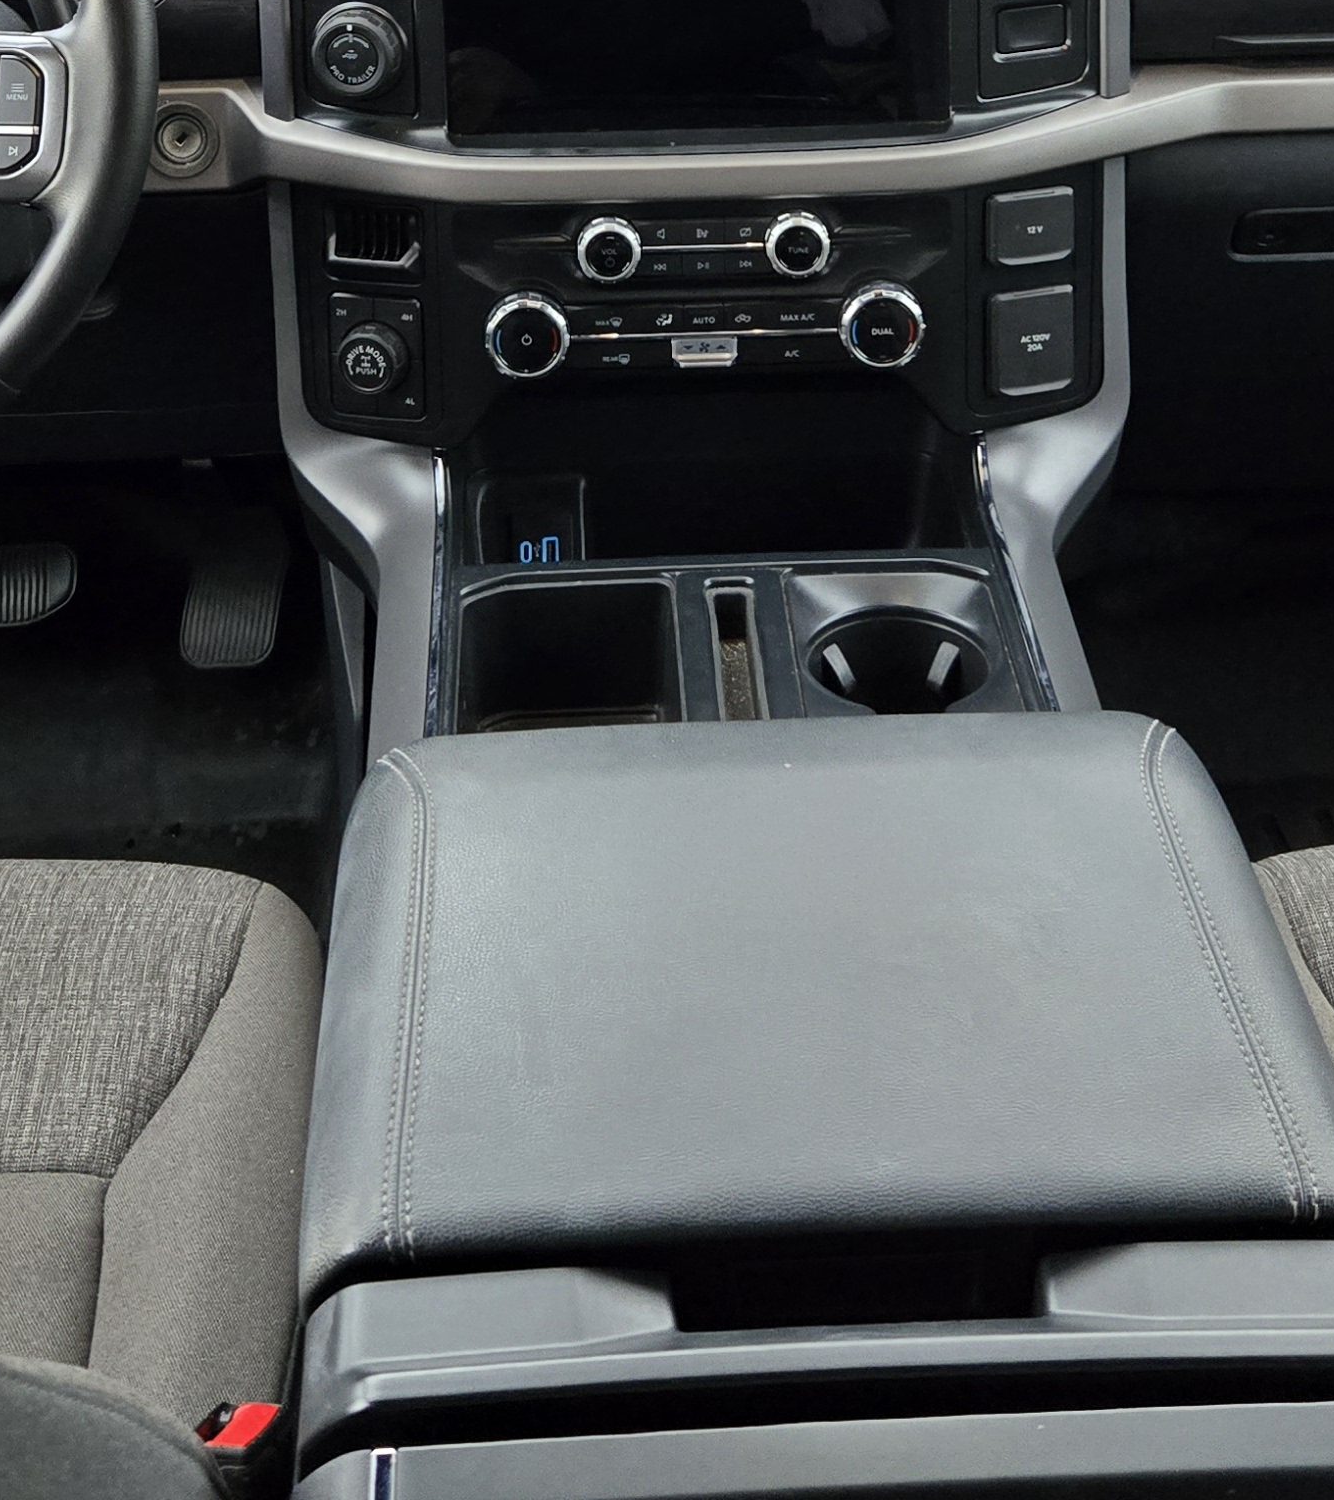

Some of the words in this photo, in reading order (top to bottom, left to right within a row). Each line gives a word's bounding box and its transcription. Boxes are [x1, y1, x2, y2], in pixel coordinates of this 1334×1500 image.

[329, 65, 345, 81] PRO
[347, 65, 376, 84] TRAILER
[5, 93, 28, 101] MENU
[1026, 226, 1036, 234] 12
[1036, 225, 1044, 234] V
[601, 248, 617, 256] VOL
[787, 246, 809, 254] TUNE
[335, 308, 347, 316] 2H
[692, 316, 716, 325] AUTO
[780, 314, 799, 322] MAX
[800, 313, 816, 321] A/C
[871, 327, 894, 336] DUAL
[1020, 335, 1032, 344] AC
[1026, 343, 1043, 352] 20A
[345, 345, 365, 366] DRIVE
[365, 345, 387, 368] MODE
[784, 350, 800, 358] A/C
[355, 367, 377, 375] PUSH
